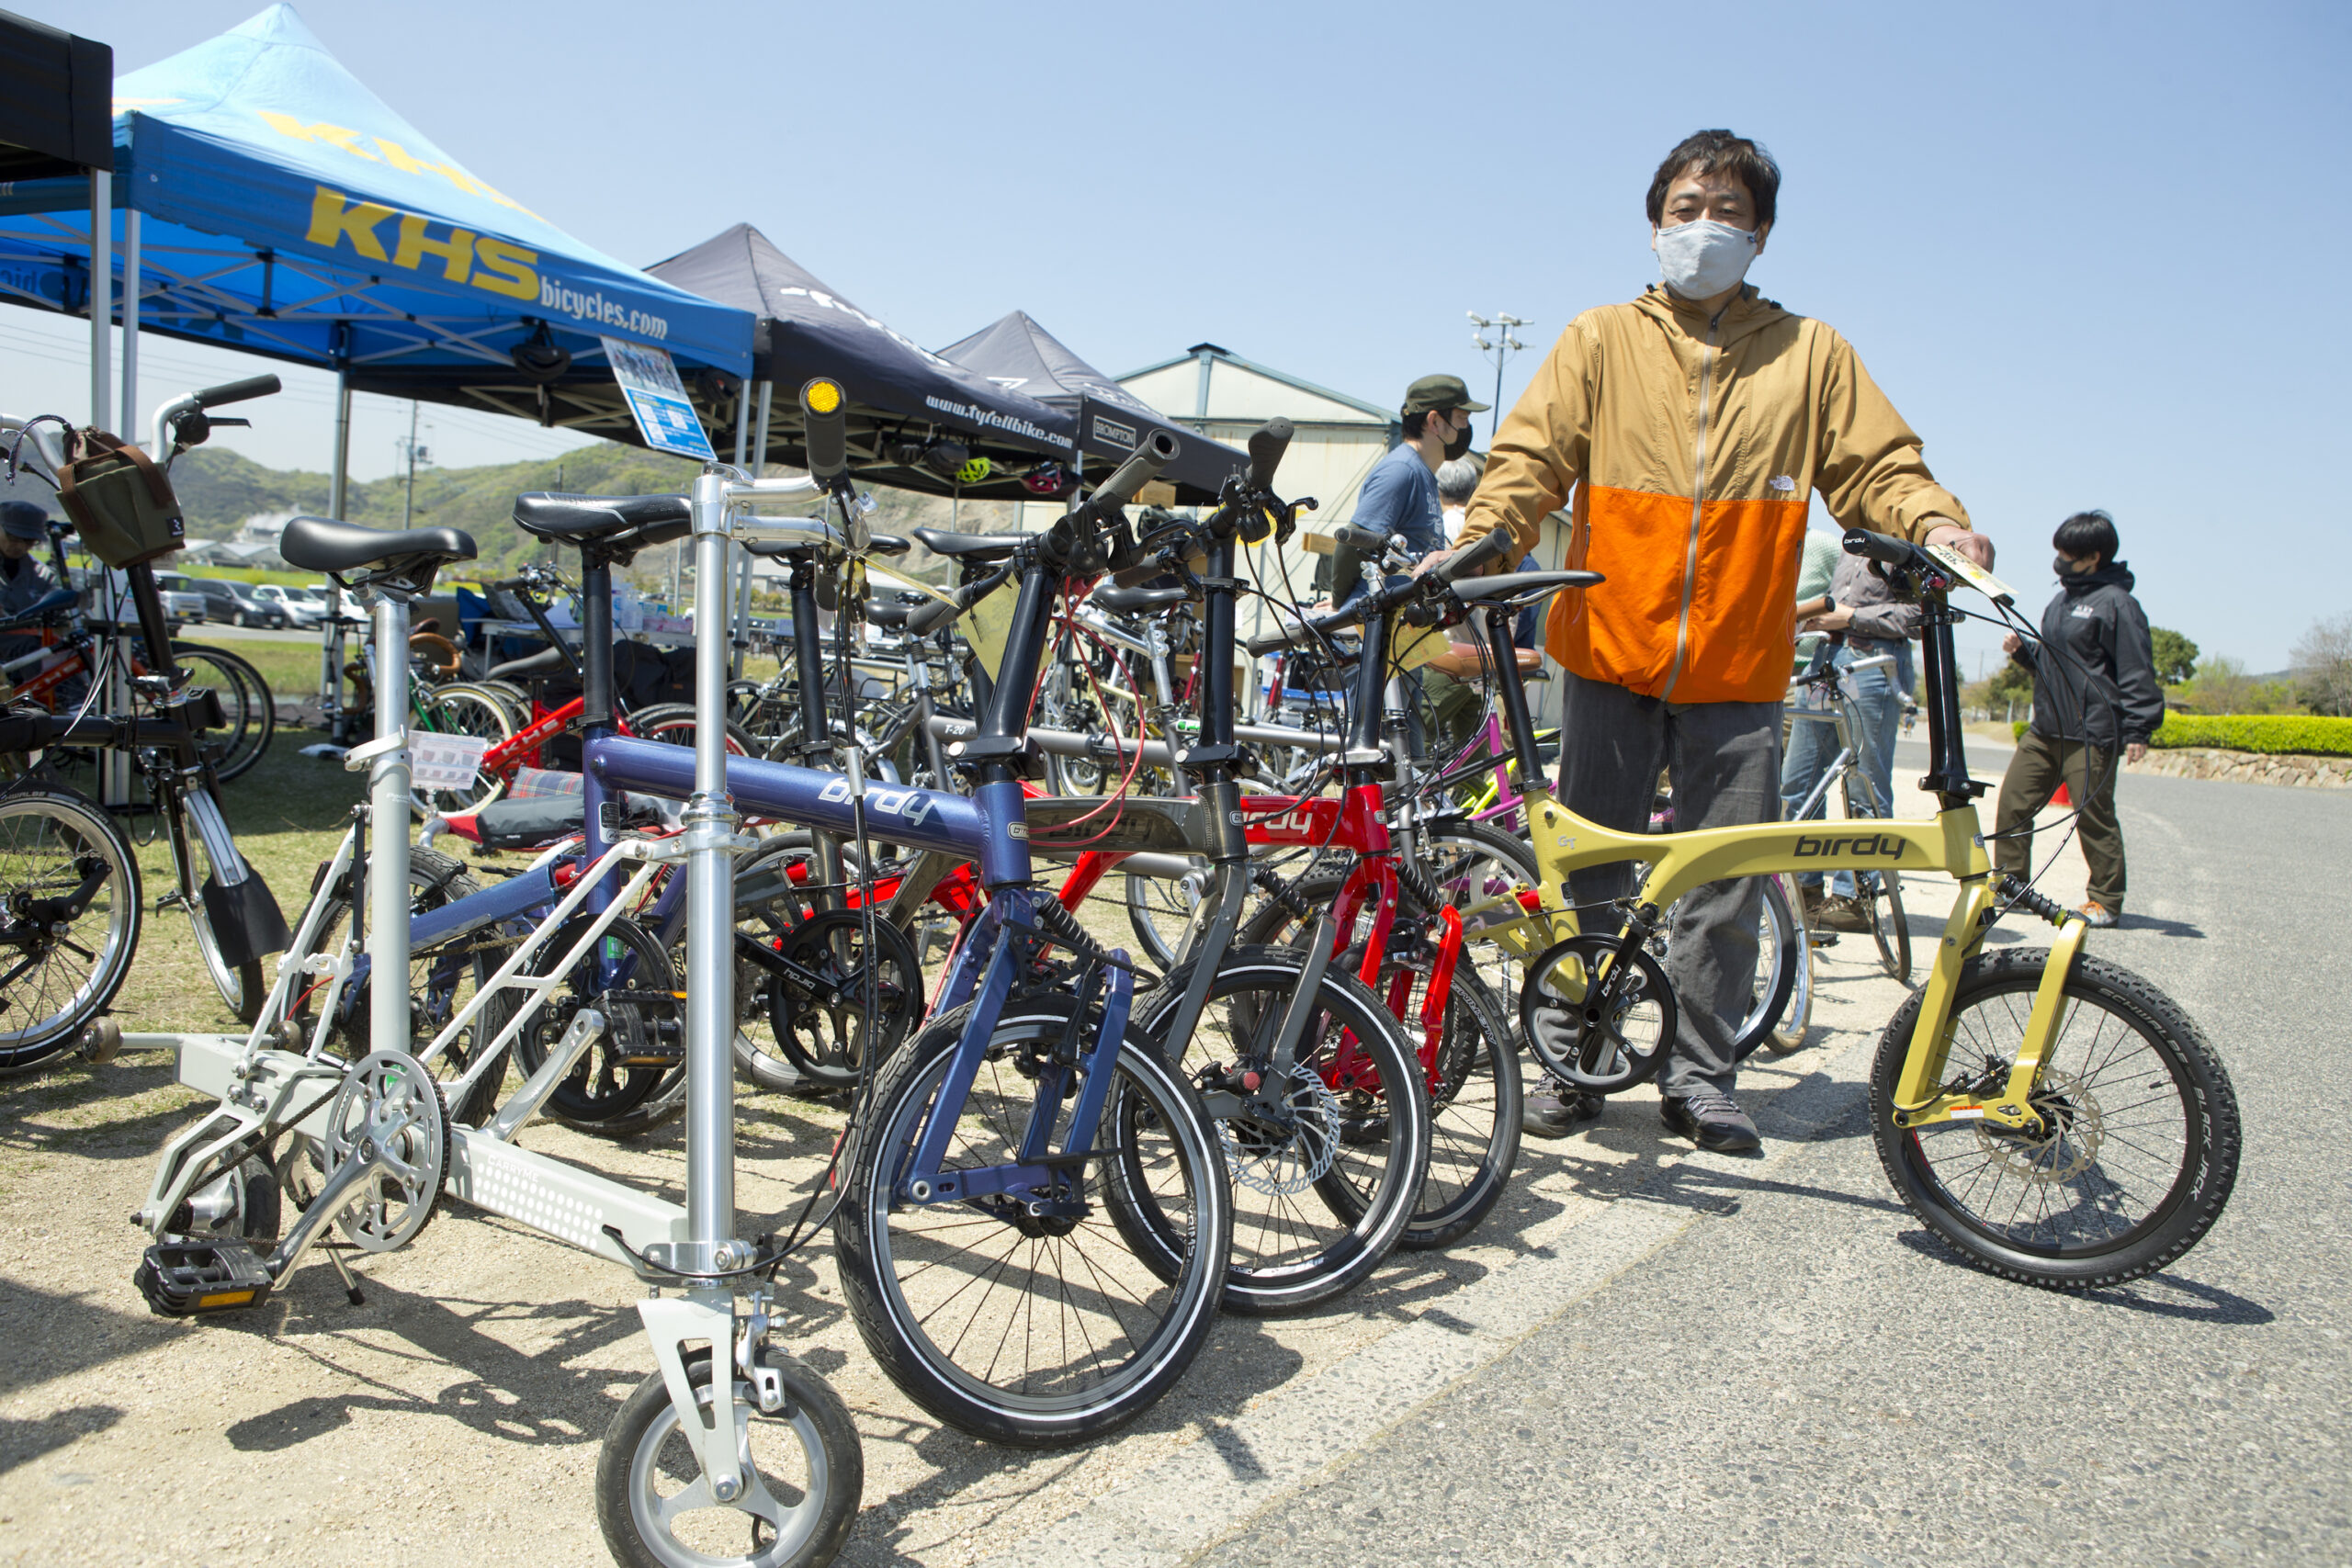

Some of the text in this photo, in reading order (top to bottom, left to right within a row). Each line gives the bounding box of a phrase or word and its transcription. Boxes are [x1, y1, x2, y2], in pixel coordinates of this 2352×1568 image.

[305, 185, 669, 341] KHS bicycles.com
[1094, 423, 1135, 446] BROMPTON
[1843, 536, 1866, 545] birdy
[502, 718, 560, 756] KHS
[944, 724, 967, 736] T-20
[1557, 834, 1577, 850] GT
[1793, 833, 1907, 861] birdy
[1600, 964, 1623, 998] birdy
[2189, 1087, 2212, 1202] BLACK JACK
